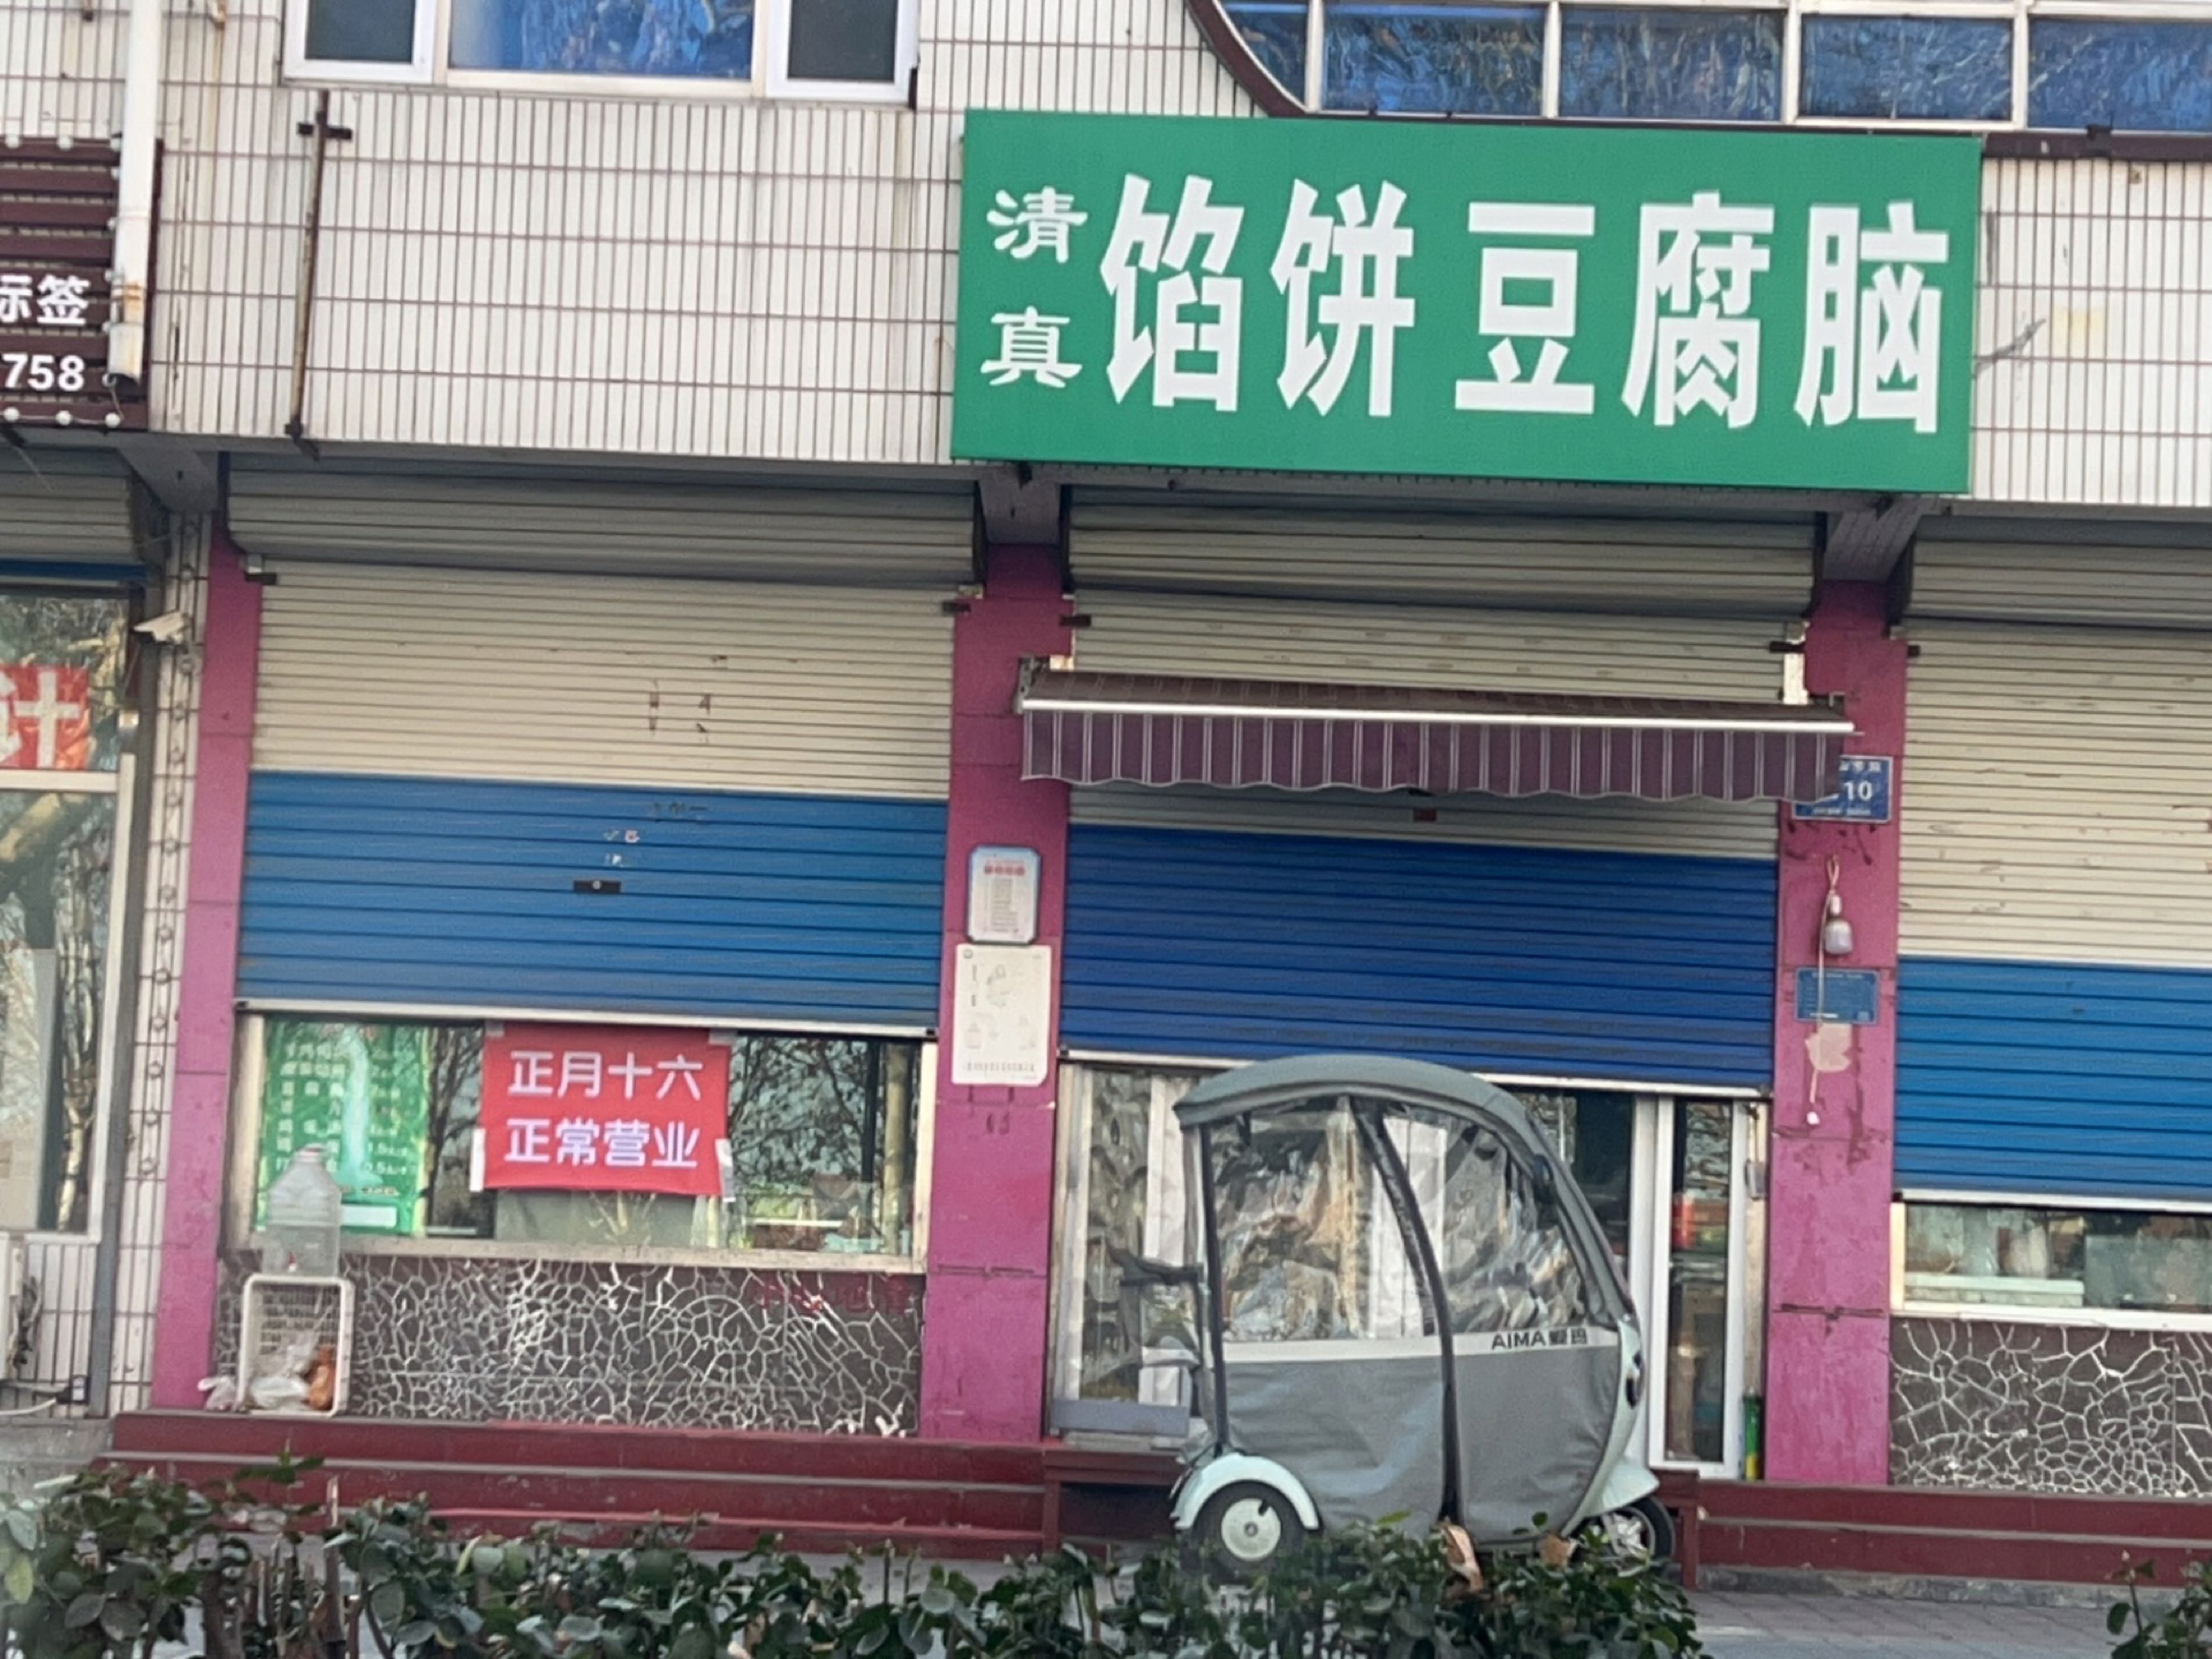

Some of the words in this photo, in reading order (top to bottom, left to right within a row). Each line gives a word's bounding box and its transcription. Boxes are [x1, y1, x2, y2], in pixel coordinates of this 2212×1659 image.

[979, 186, 1087, 388] 清真
[1098, 173, 1948, 433] 馅饼豆腐脑
[3, 353, 84, 391] 758
[1843, 780, 1873, 801] 10
[508, 1050, 703, 1100] 正月十六
[504, 1116, 700, 1169] 正常营业
